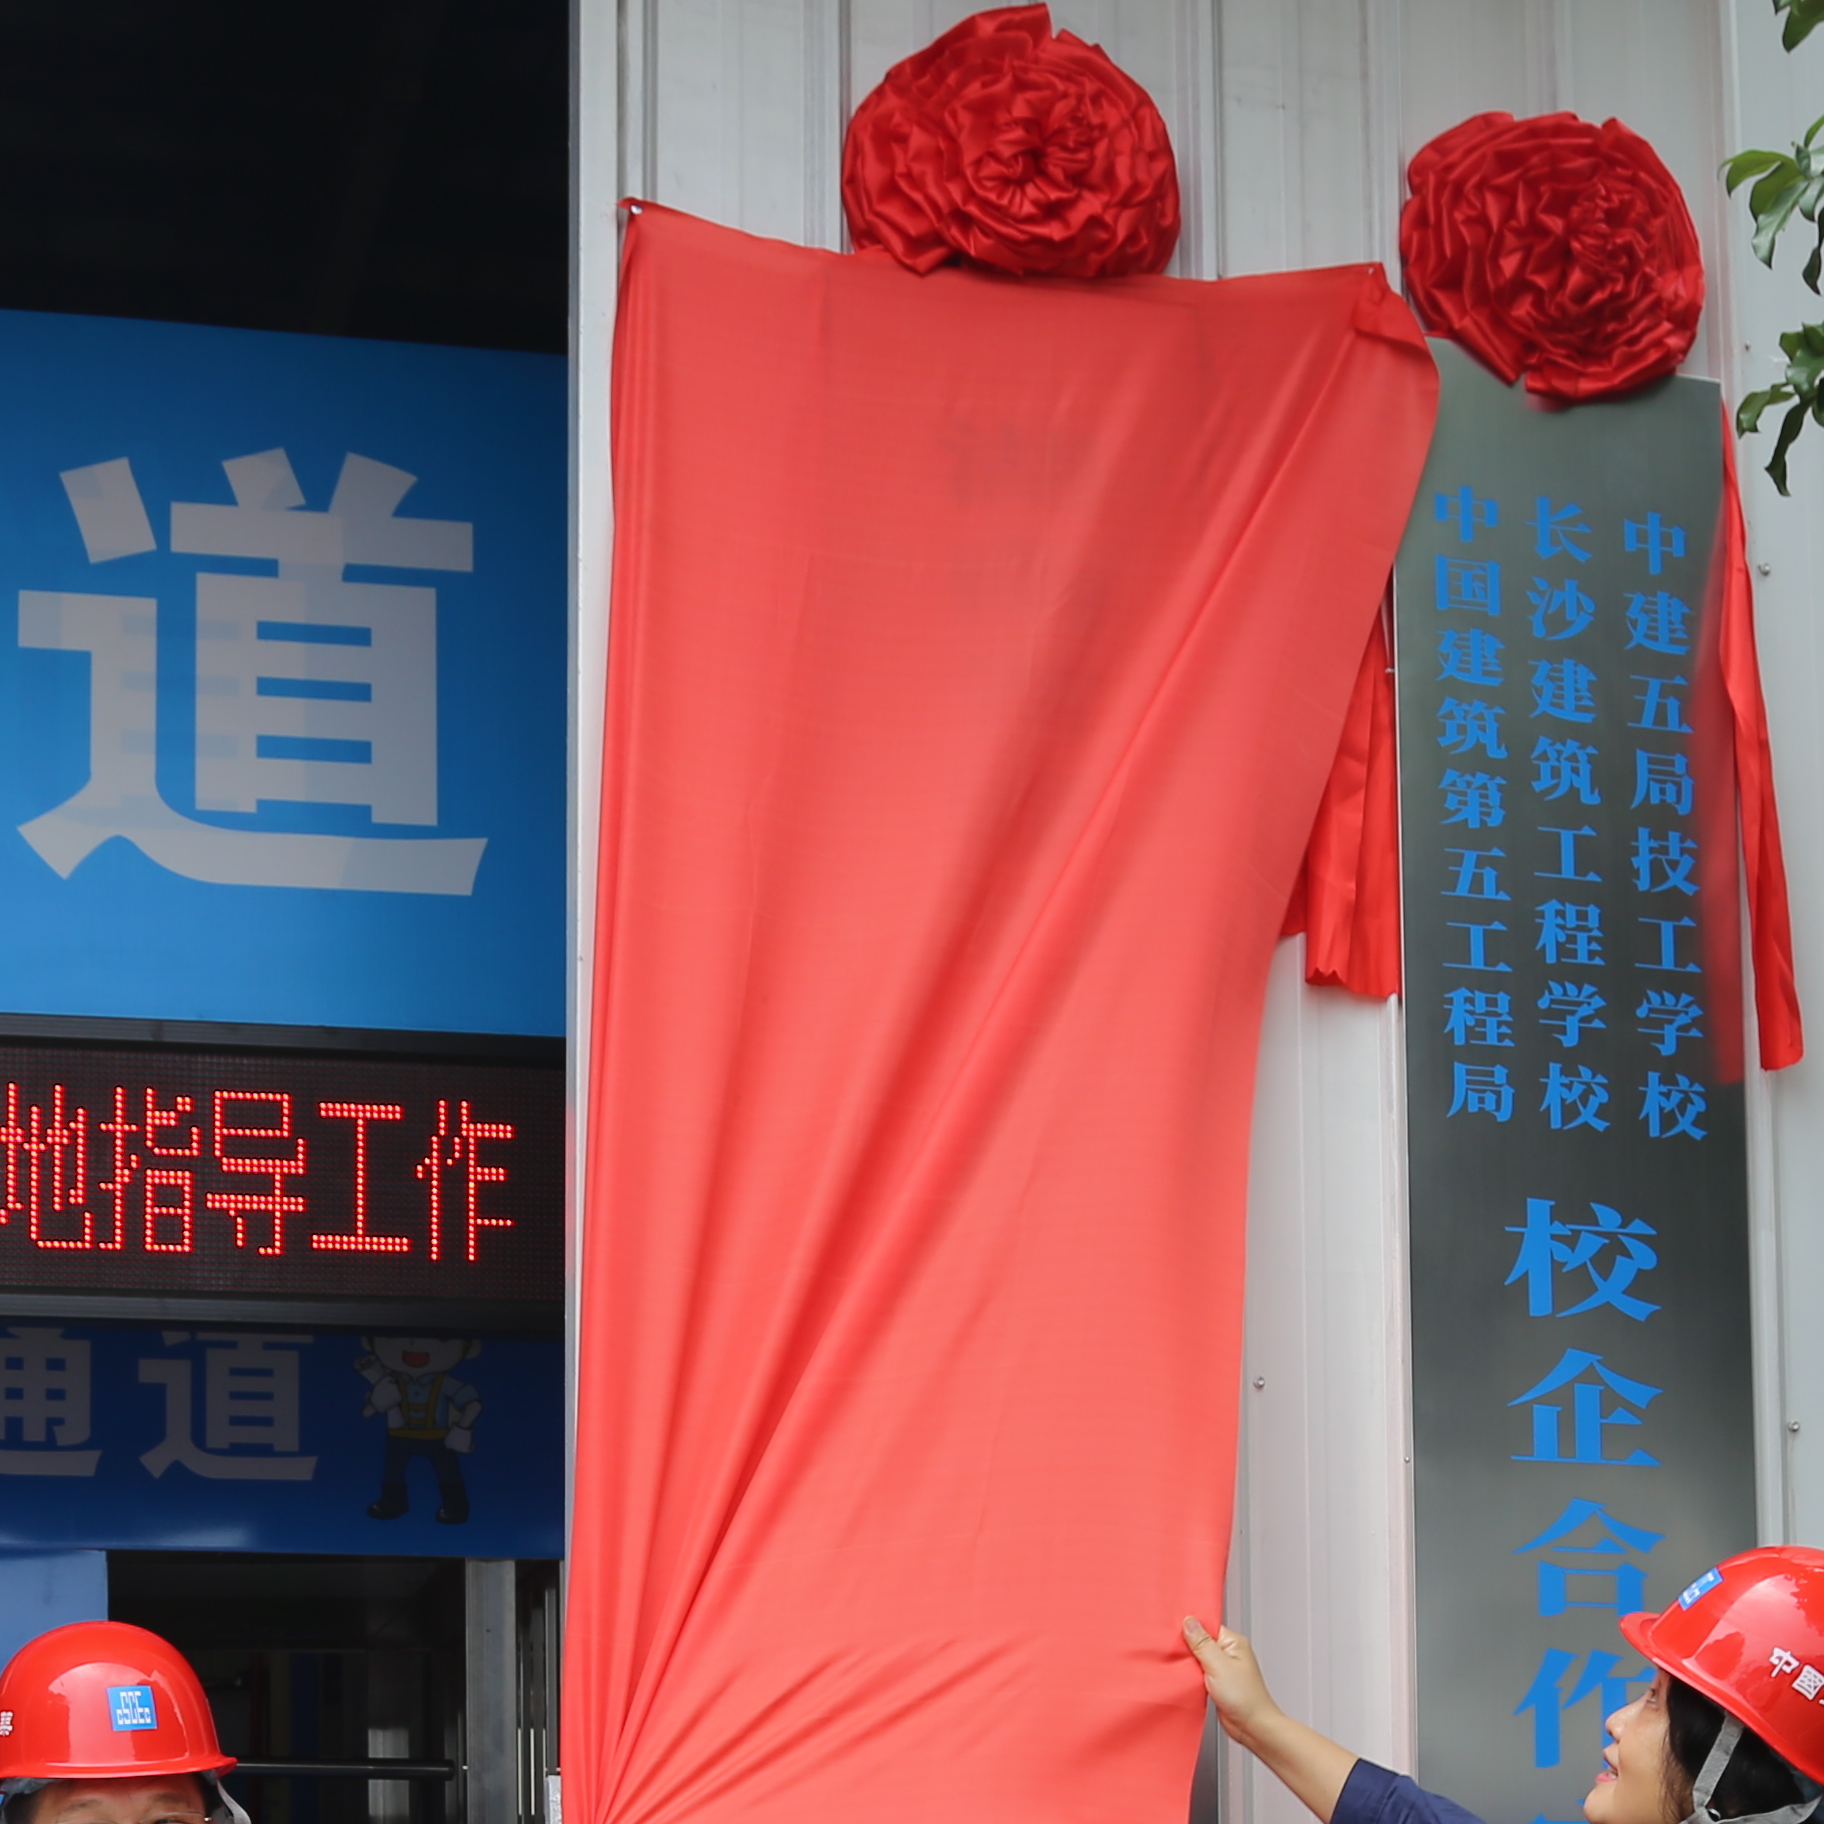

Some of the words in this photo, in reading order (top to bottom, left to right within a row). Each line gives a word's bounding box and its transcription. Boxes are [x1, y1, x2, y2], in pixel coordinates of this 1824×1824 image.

[1433, 486, 1517, 1124] 中国建筑第五工程局
[1526, 496, 1611, 1134] 长沙建筑工程学校
[1623, 511, 1709, 1142] 中建五局技工学校
